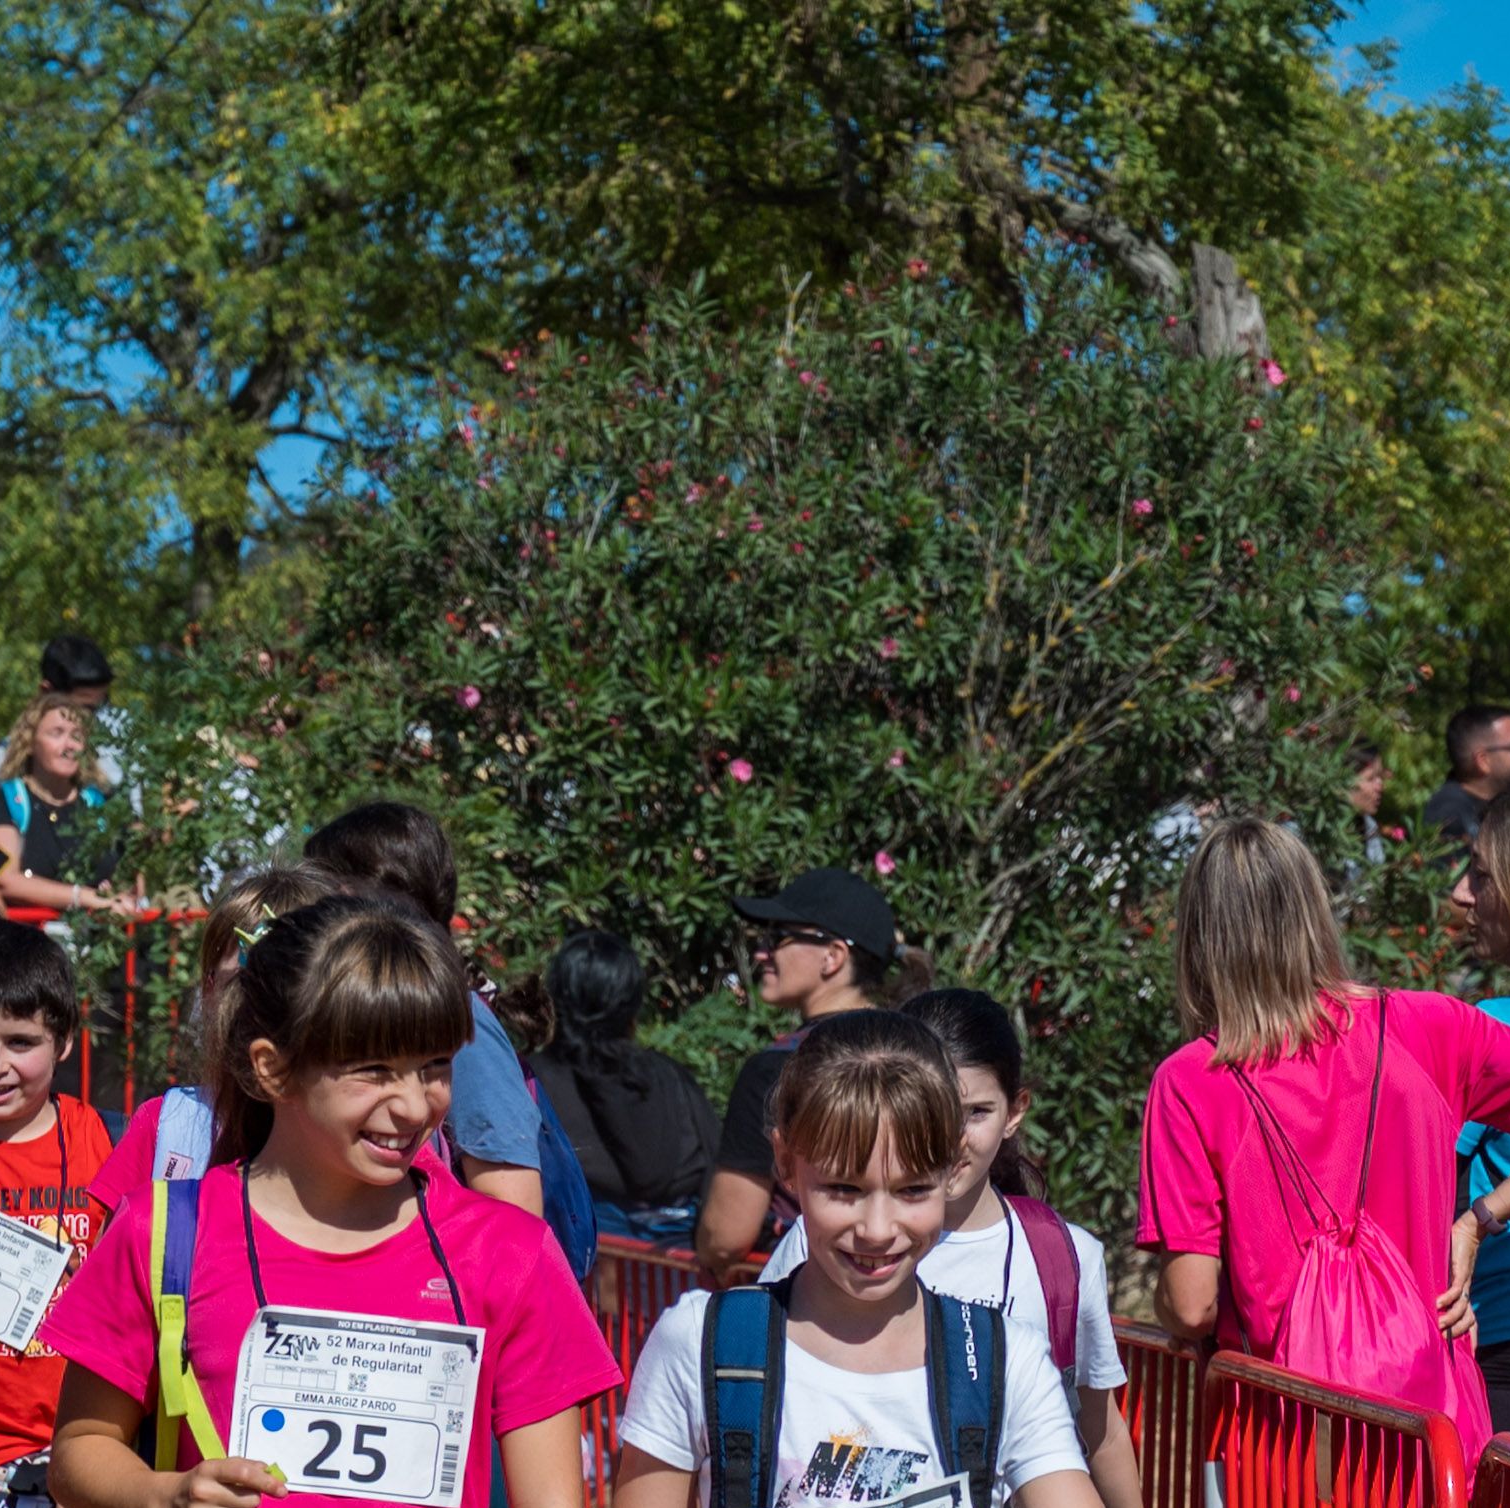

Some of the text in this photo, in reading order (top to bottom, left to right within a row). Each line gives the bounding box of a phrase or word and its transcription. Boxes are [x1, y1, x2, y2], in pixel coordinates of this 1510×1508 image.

[29, 1186, 89, 1209] KONG
[2, 1229, 30, 1249] Infantil
[337, 1320, 351, 1329] NO
[351, 1321, 364, 1330] EM
[326, 1335, 432, 1358] 52 Marxa Infantil
[332, 1353, 348, 1367] de
[351, 1355, 423, 1375] Regularitat
[294, 1392, 397, 1412] EMMA ARGIZ PARDO
[302, 1419, 388, 1484] 25
